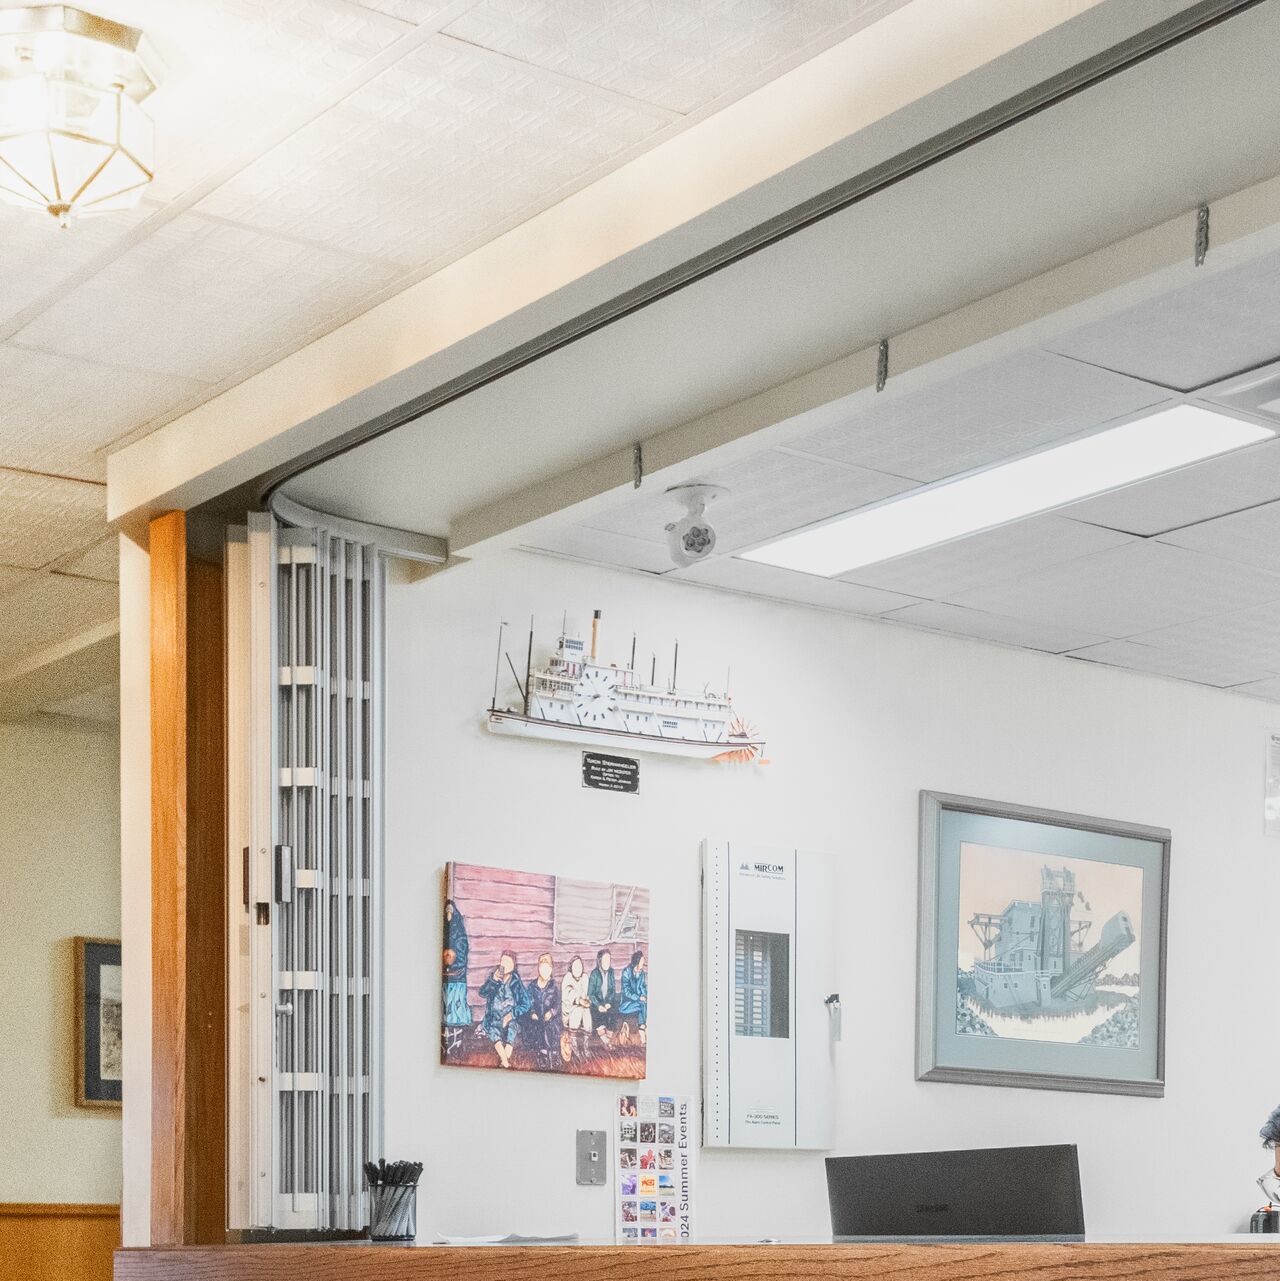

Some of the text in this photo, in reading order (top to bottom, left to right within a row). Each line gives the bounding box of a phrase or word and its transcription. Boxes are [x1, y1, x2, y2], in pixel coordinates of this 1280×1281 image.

[754, 863, 784, 873] MIRCOM
[678, 1103, 687, 1149] Events
[680, 1152, 689, 1211] Summer
